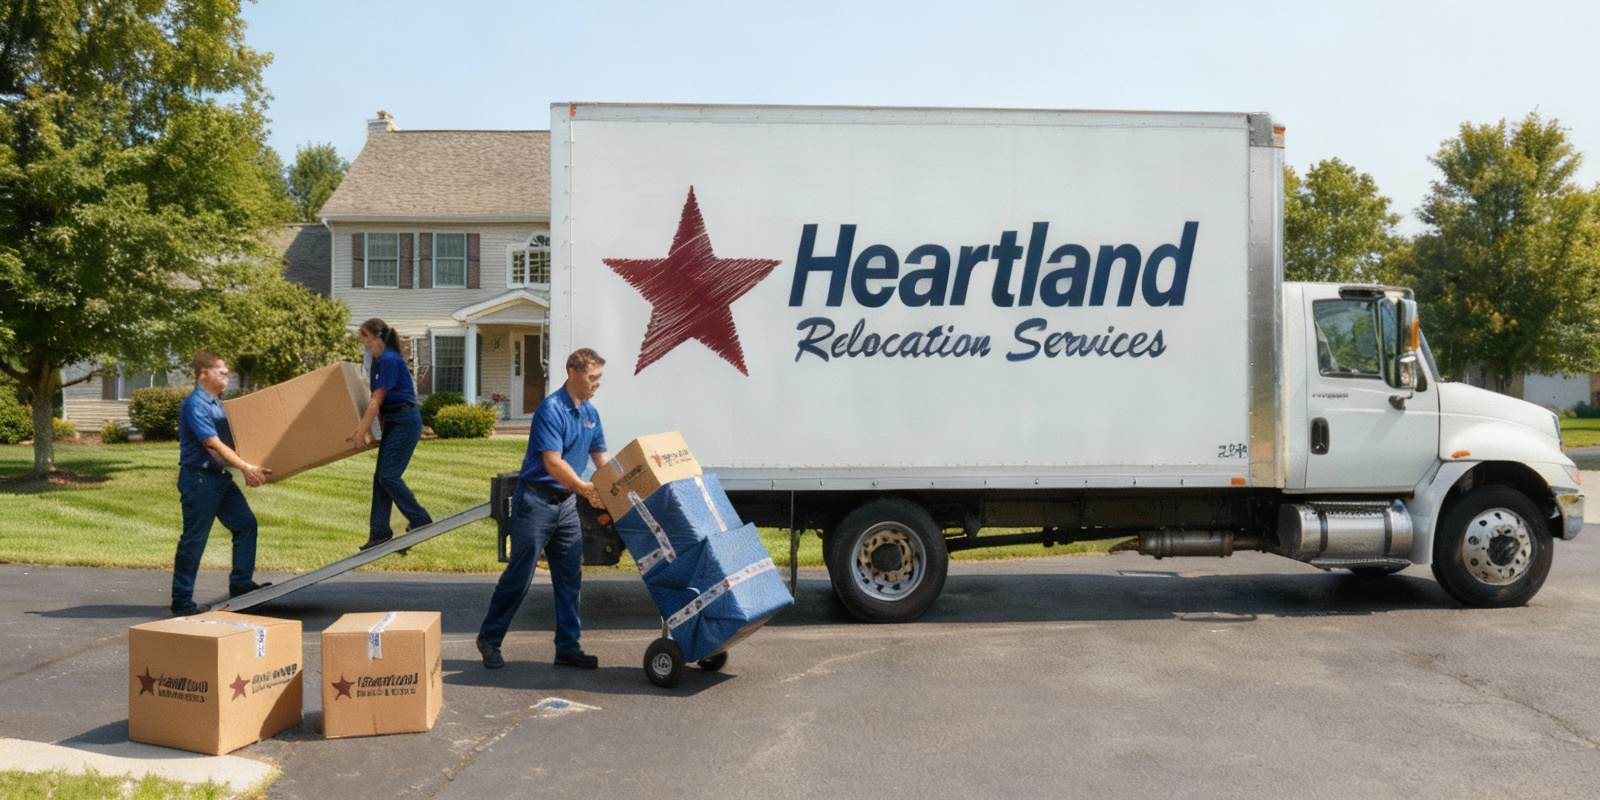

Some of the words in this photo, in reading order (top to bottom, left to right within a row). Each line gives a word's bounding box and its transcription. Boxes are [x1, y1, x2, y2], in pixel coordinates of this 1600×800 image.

[788, 221, 1199, 308] Heartland
[795, 317, 991, 362] Relocation
[1006, 317, 1167, 362] Services
